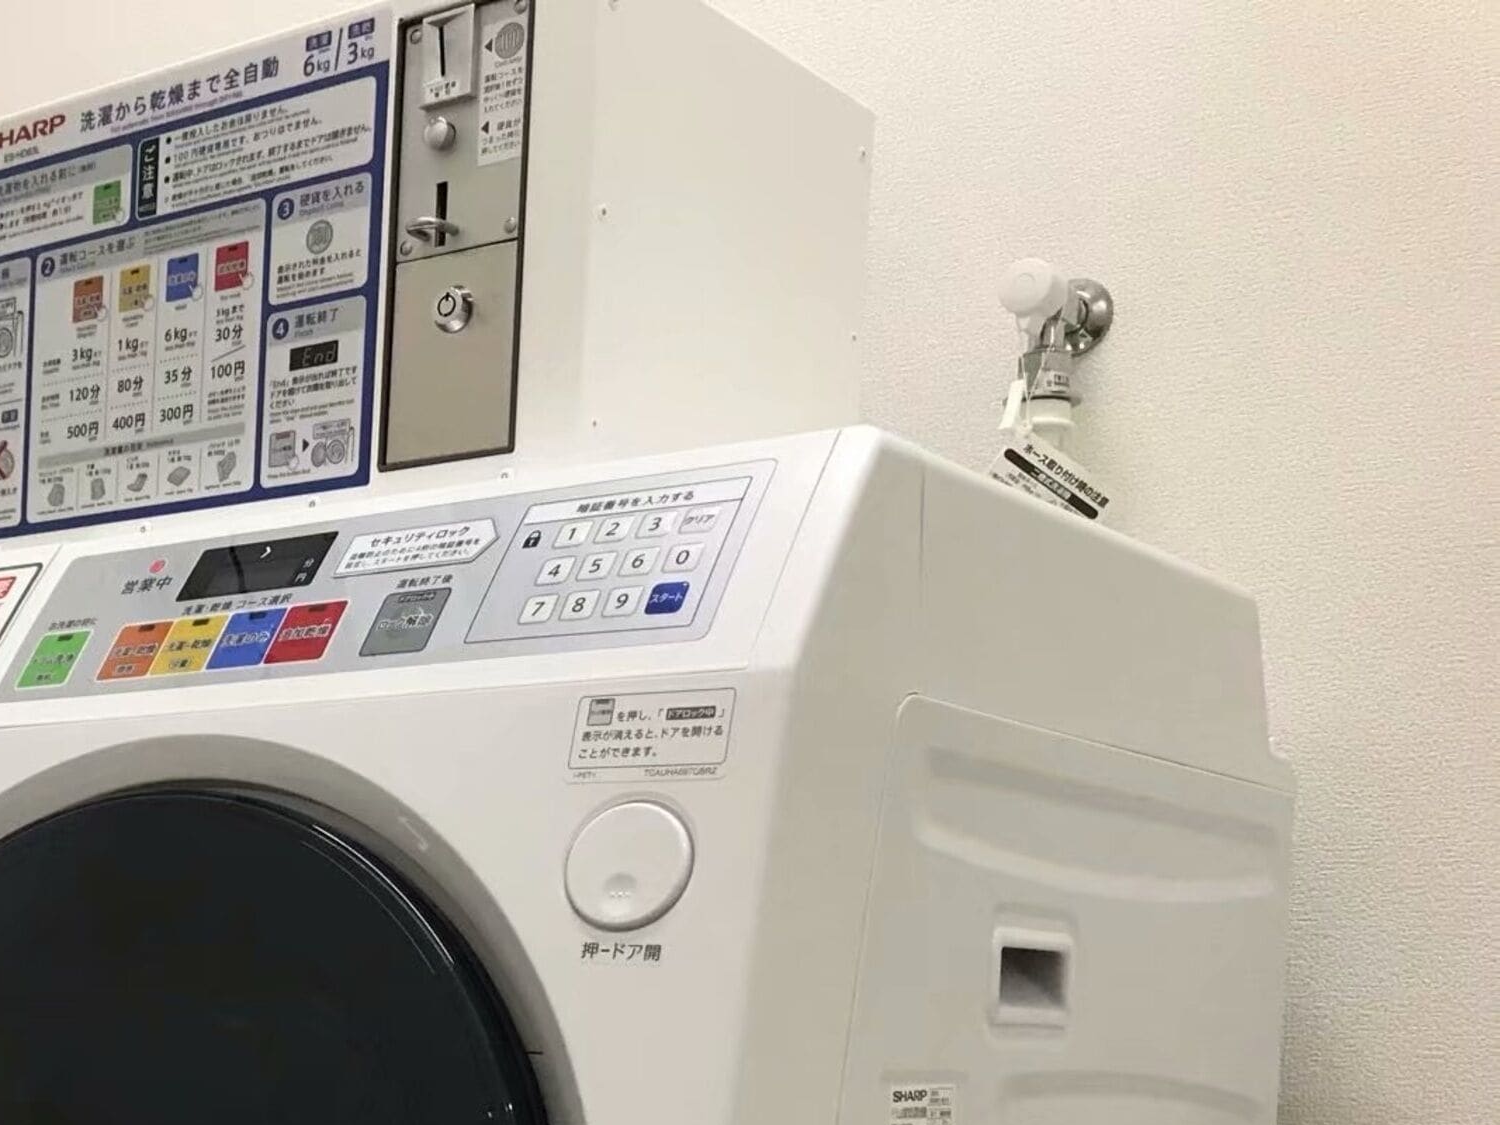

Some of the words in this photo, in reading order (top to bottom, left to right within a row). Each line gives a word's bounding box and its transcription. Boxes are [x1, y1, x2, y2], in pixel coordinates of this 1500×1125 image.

[81, 56, 280, 132] 洗濯から乾燥まで全自動
[300, 180, 364, 206] 硬貨を入れる
[294, 308, 339, 328] 運転終了
[215, 325, 243, 342] 30分
[302, 343, 337, 367] End
[164, 366, 192, 384] 35分
[211, 360, 245, 380] 100円
[117, 376, 144, 393] 80分
[70, 385, 100, 402] 120分
[112, 412, 145, 431] 400円
[160, 404, 194, 422] 300円
[67, 421, 99, 440] 500円
[1024, 444, 1110, 508] ホース取り付け時の注意
[576, 490, 695, 513] 暗証番号を入力する
[606, 523, 619, 536] 2
[649, 517, 661, 531] 3
[370, 524, 472, 547] セキュリティロック
[565, 528, 576, 541] 1
[302, 558, 315, 569] 分
[589, 559, 601, 572] 5
[631, 554, 644, 568] 6
[675, 550, 689, 564] 0
[547, 564, 561, 577] 4
[120, 576, 174, 595] 営業中
[396, 574, 453, 589] 運転終了後
[572, 597, 585, 612] 8
[615, 594, 628, 609] 9
[649, 590, 683, 606] スタート
[533, 601, 546, 616] 7
[581, 725, 724, 742] 表示が消えると、ドアを開ける
[577, 747, 658, 759] ことができます。
[892, 1090, 928, 1103] SHARP
